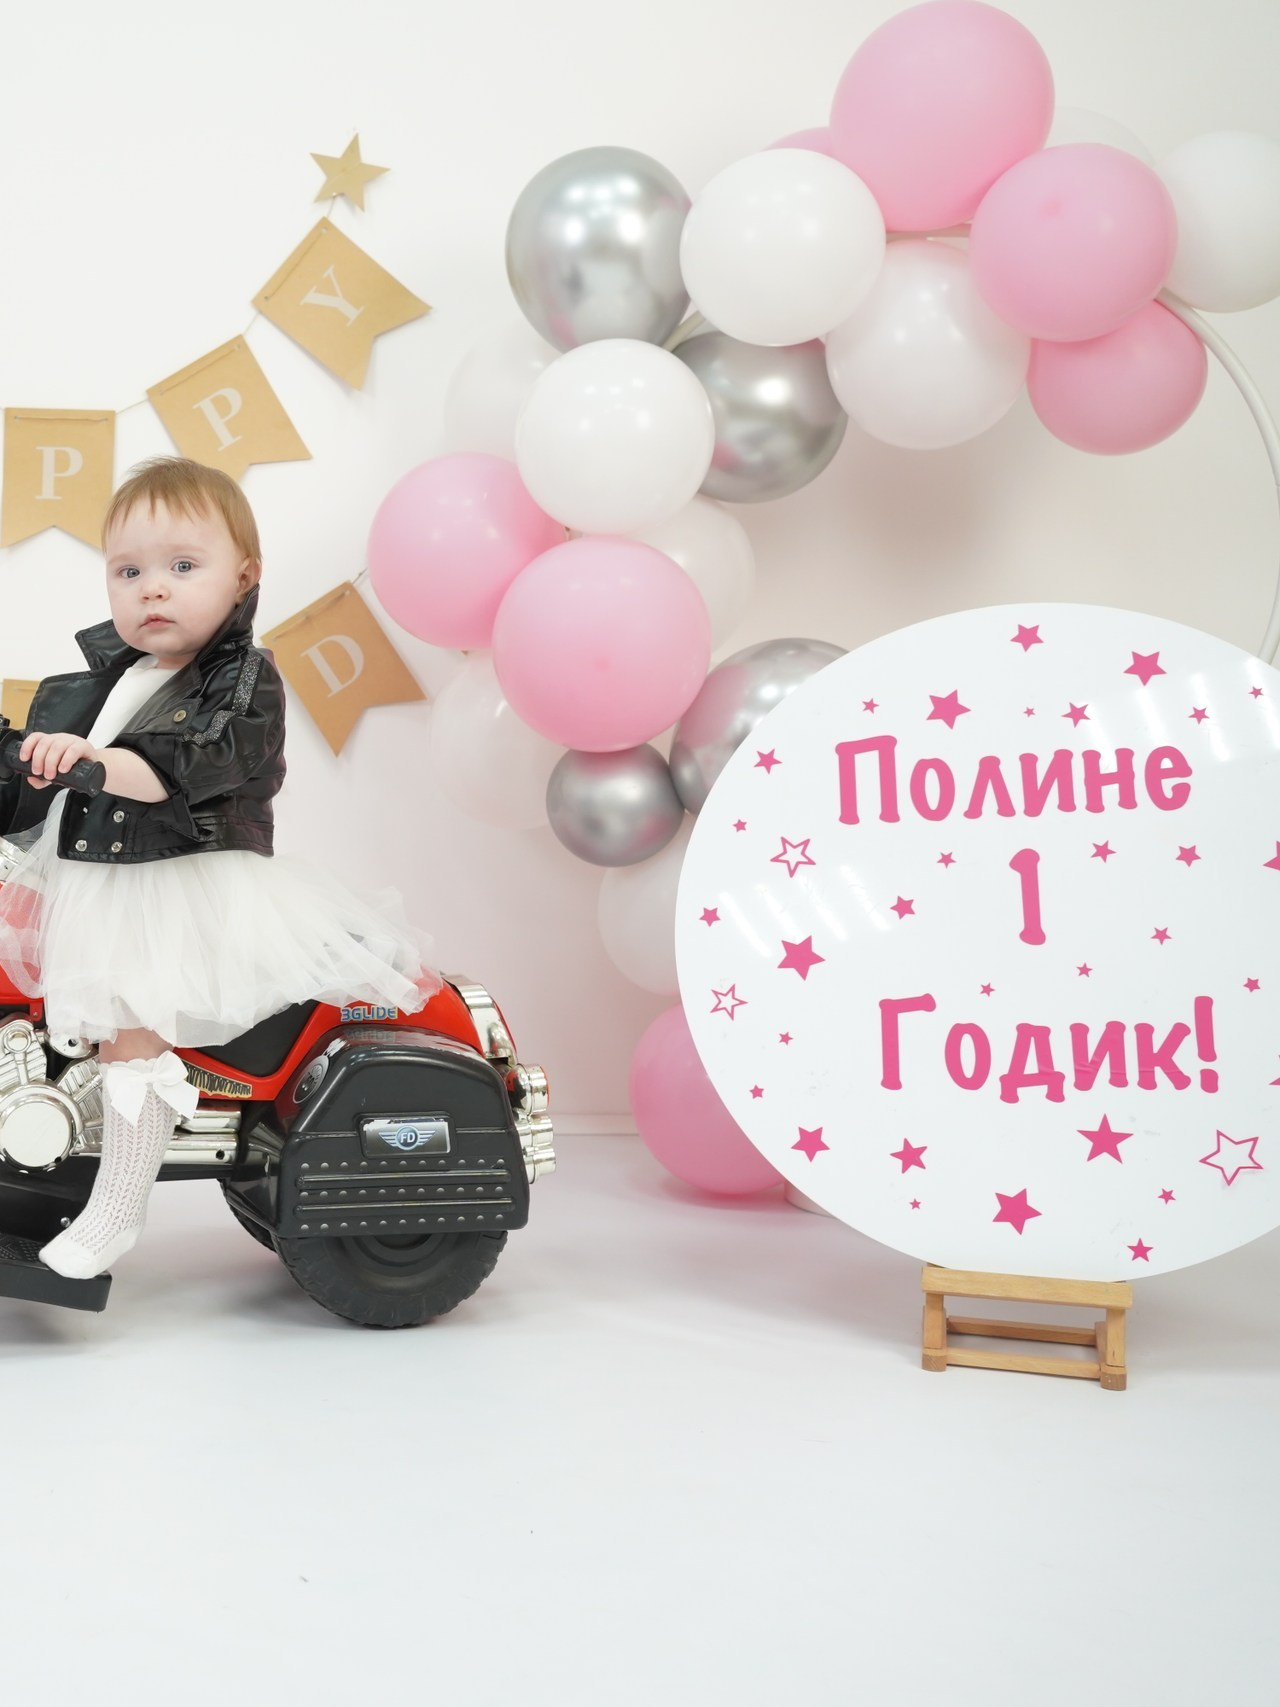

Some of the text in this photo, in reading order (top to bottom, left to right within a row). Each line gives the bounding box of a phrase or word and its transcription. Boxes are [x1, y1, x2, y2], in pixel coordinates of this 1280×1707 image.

[835, 736, 1192, 825] Полине
[1009, 848, 1047, 945] 1
[879, 994, 1218, 1103] Годик!
[400, 1132, 416, 1143] FD
